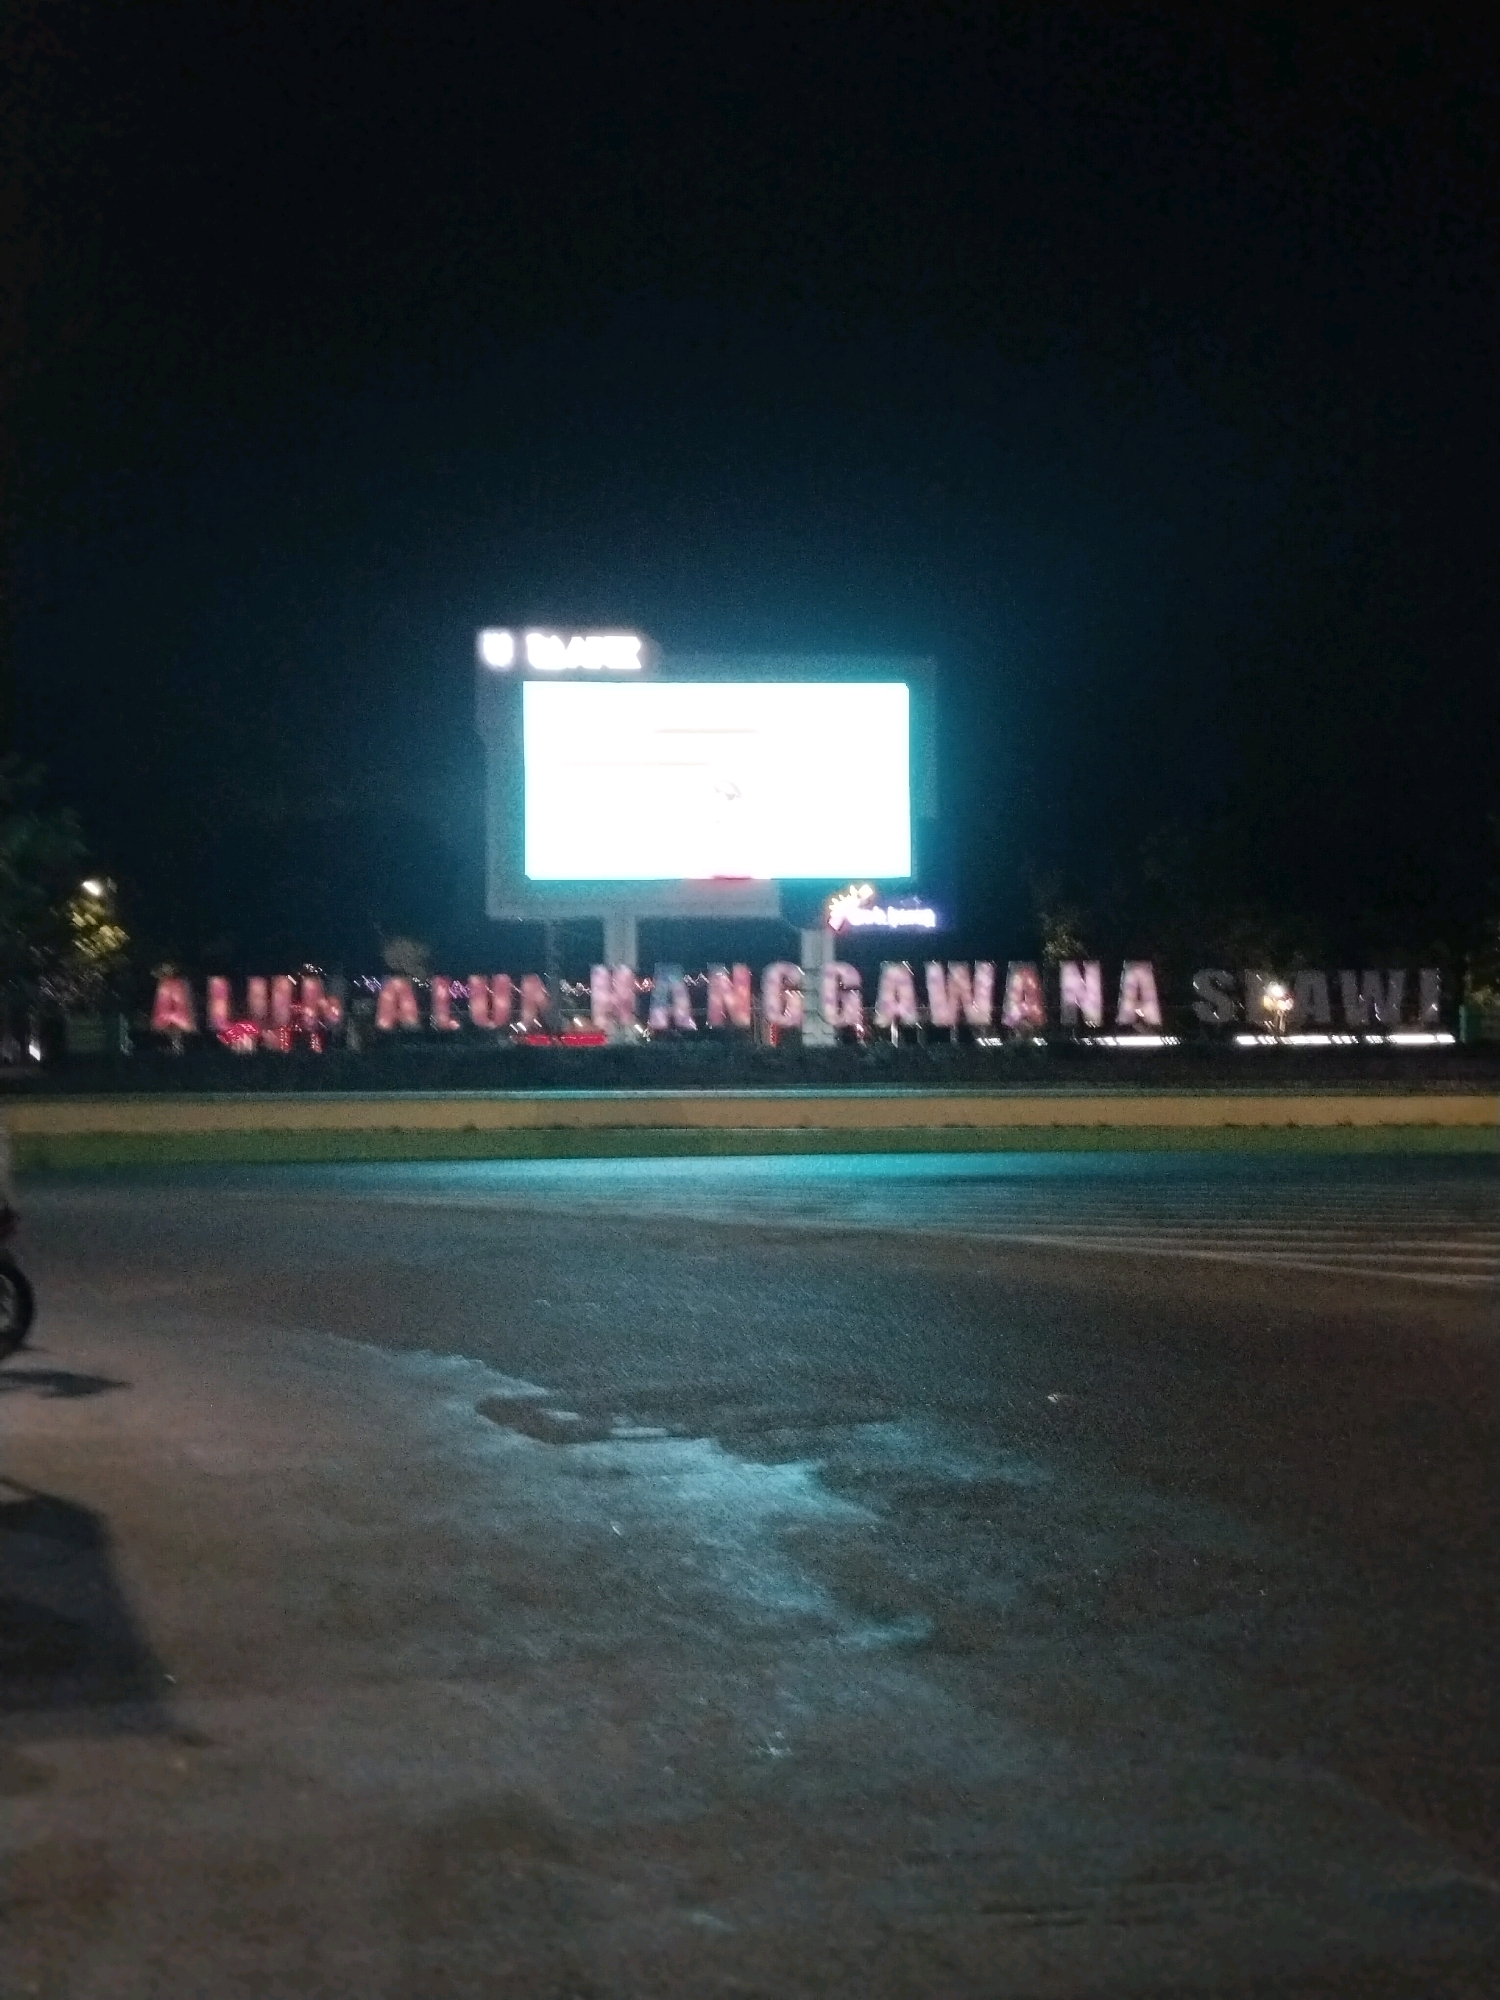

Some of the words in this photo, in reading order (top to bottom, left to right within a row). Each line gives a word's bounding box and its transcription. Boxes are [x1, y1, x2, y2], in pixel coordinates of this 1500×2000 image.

[151, 974, 347, 1031] ALUN
[375, 973, 556, 1031] ALUN
[590, 961, 1162, 1030] HANGGAWANA
